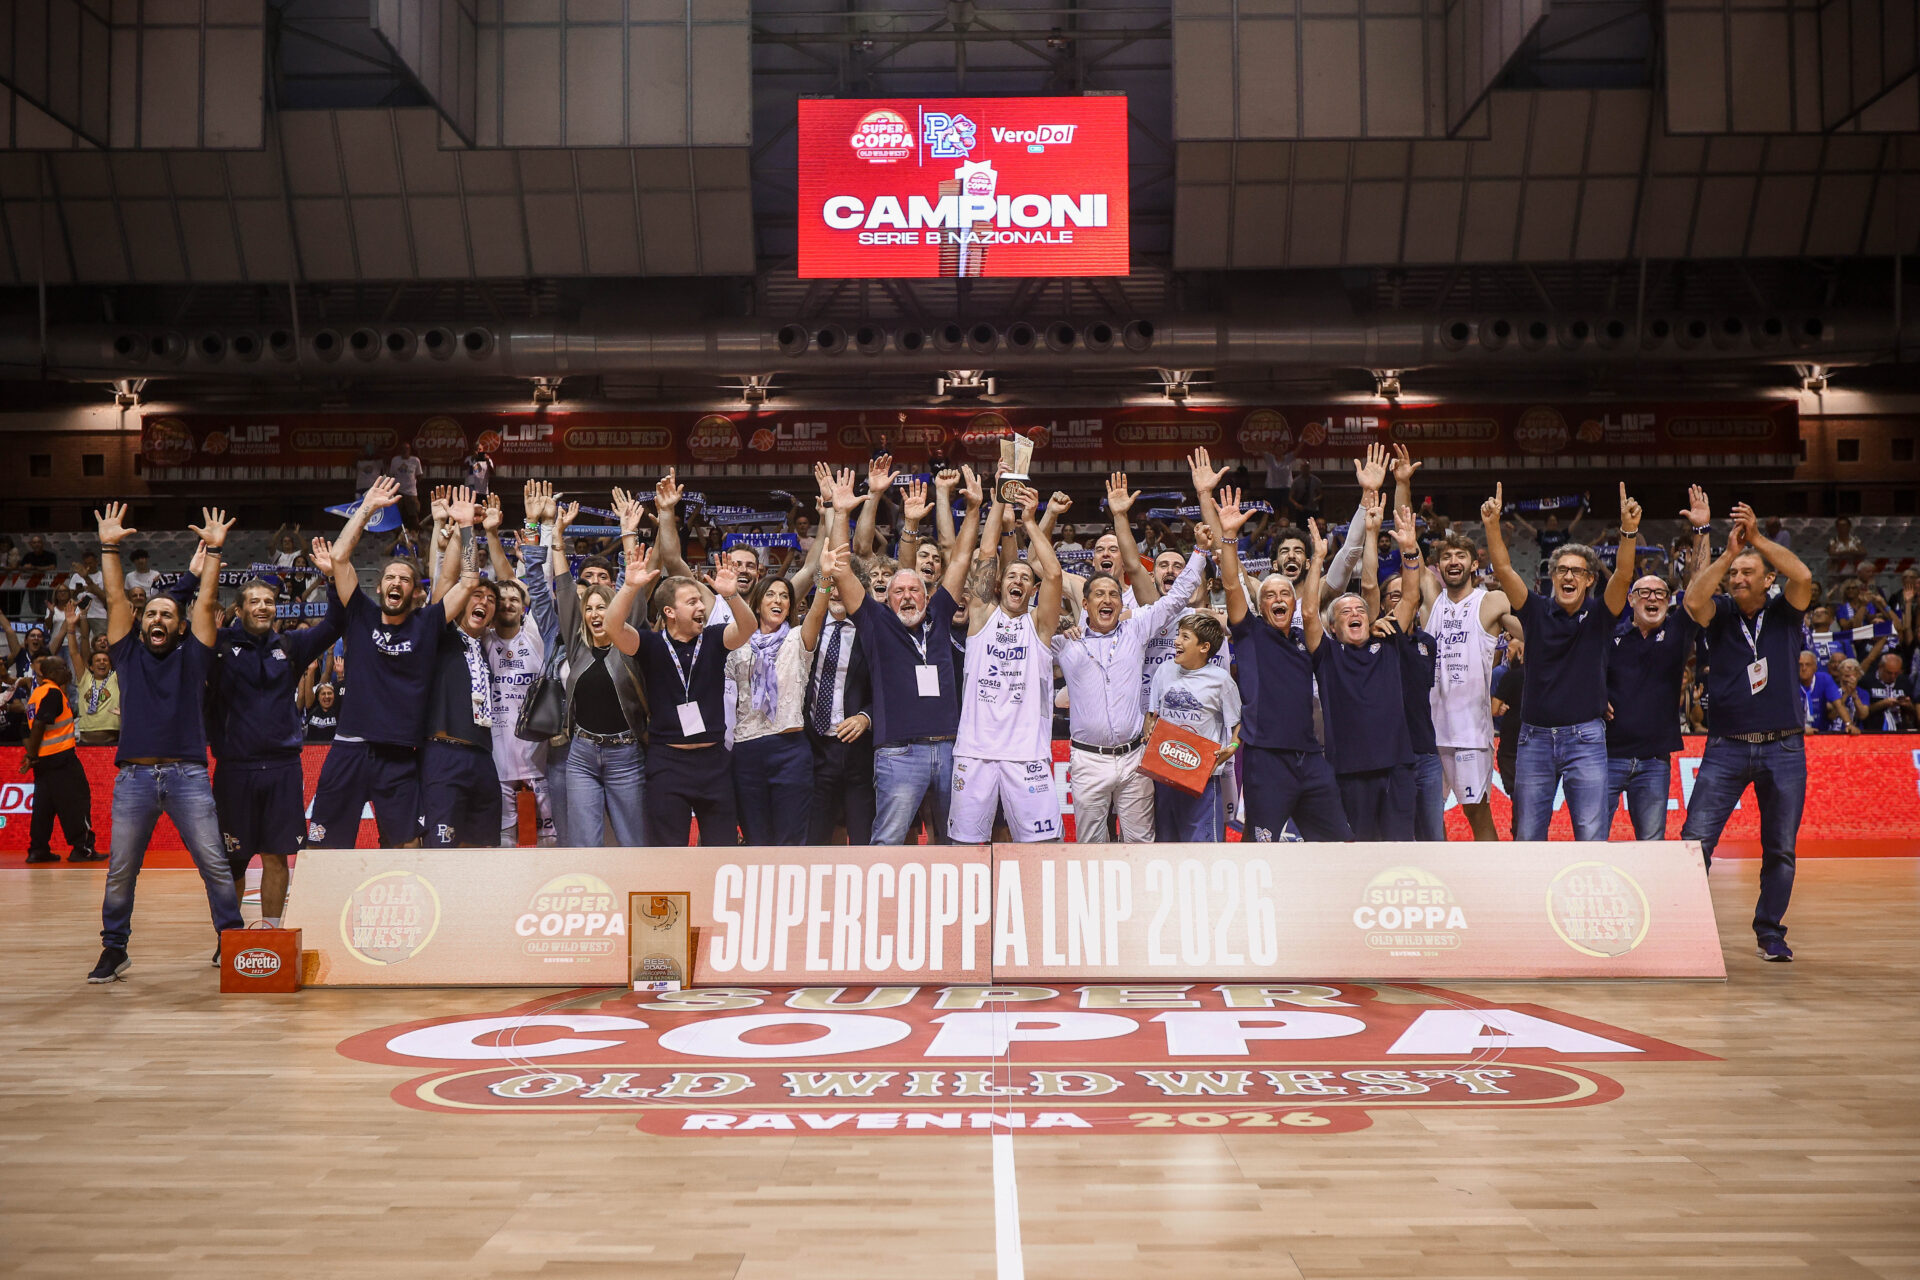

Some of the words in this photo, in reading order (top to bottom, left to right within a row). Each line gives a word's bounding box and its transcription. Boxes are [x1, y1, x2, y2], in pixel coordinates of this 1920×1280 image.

[862, 124, 904, 133] SUPER
[990, 126, 1071, 143] VeroDol
[851, 134, 914, 148] COPPA
[822, 194, 1108, 229] CAMPIONI
[858, 231, 919, 245] SERIE
[925, 231, 942, 245] B
[948, 230, 1074, 244] NAZIONALE
[1052, 419, 1103, 436] LNP
[1327, 417, 1379, 432] LNP
[1395, 423, 1420, 436] OLD
[1422, 423, 1456, 436] WILD
[1457, 422, 1491, 436] WEST
[1603, 413, 1656, 430] LNP
[229, 425, 280, 442] LNP
[502, 424, 554, 440] LNP
[776, 422, 828, 439] LNP
[1119, 427, 1144, 440] OLD
[1146, 427, 1180, 440] WILD
[1181, 426, 1216, 439] WEST
[1240, 430, 1291, 442] COPPA
[1515, 427, 1568, 439] COPPA
[142, 438, 192, 451] COPPA
[415, 437, 466, 449] COPPA
[570, 432, 594, 445] OLD
[596, 432, 629, 445] WILD
[631, 432, 666, 445] WEST
[690, 436, 739, 447] COPPA
[768, 539, 792, 547] FEDE
[1014, 622, 1024, 631] 11
[494, 673, 541, 685] eroDol
[1162, 710, 1202, 721] LANVIN
[1161, 743, 1198, 766] Beretta
[1465, 786, 1474, 797] 1
[1227, 802, 1234, 814] 9
[1034, 819, 1055, 833] 11
[1568, 875, 1618, 896] OLD
[369, 884, 417, 905] OLD
[1371, 889, 1446, 904] SUPER
[536, 896, 610, 911] SUPER
[1564, 896, 1629, 918] WILD
[360, 905, 420, 926] WILD
[710, 860, 1029, 972] SUPERCOPPA
[1042, 859, 1133, 967] LNP
[1145, 858, 1278, 967] 2026
[1353, 906, 1468, 929] COPPA
[515, 913, 626, 936] COPPA
[1562, 918, 1635, 940] WEST
[352, 927, 421, 948] WEST
[1371, 936, 1393, 945] OLD
[1394, 936, 1423, 945] WILD
[1424, 936, 1455, 945] WEST
[527, 942, 549, 952] OLD
[551, 942, 578, 952] WILD
[580, 942, 610, 952] WEST
[236, 955, 278, 970] Beretta
[638, 983, 1361, 1011] SUPER
[386, 1009, 1647, 1060] COPPA
[487, 1072, 756, 1099] OLD
[782, 1071, 1126, 1099] WILD
[1134, 1069, 1518, 1097] WEST
[680, 1112, 1094, 1132] RAVENNA
[1128, 1111, 1332, 1129] 2026
